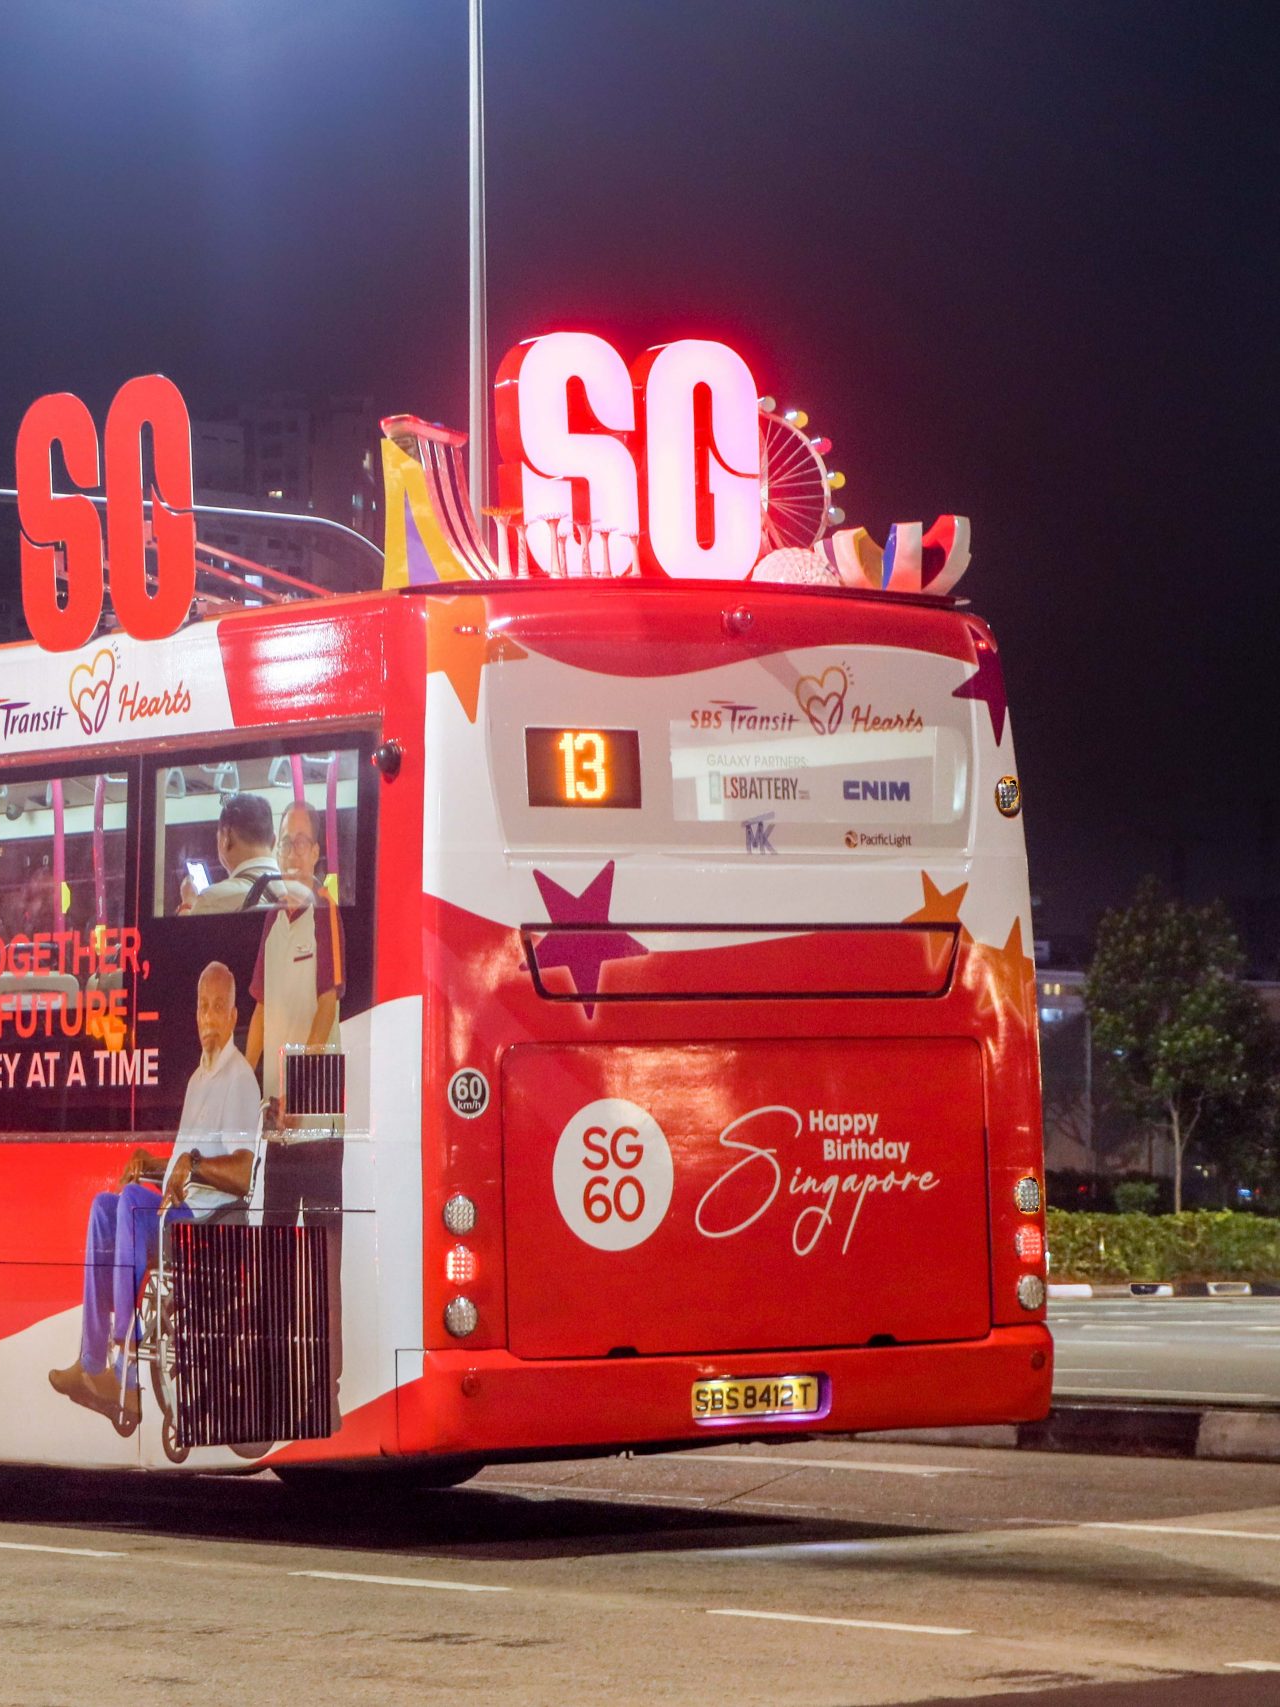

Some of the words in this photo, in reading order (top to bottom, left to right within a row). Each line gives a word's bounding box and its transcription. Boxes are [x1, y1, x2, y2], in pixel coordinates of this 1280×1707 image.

[496, 332, 760, 580] SG
[16, 373, 196, 652] SG
[118, 681, 191, 723] Hearts
[690, 710, 722, 729] SBS
[721, 705, 799, 733] Transit
[851, 704, 923, 732] Hearts
[559, 733, 606, 799] 13
[707, 754, 750, 767] GALAXY
[754, 755, 808, 768] PARTNERS:
[843, 780, 910, 801] CNIM
[26, 1051, 60, 1088] AT
[66, 1051, 86, 1087] A
[94, 1048, 159, 1086] TIME
[455, 1076, 482, 1100] 60
[457, 1100, 481, 1109] km/h
[809, 1109, 879, 1136] Happy
[582, 1126, 644, 1171] SG
[823, 1138, 910, 1163] Birthday
[583, 1176, 646, 1224] 60
[695, 1105, 940, 1257] Singapore
